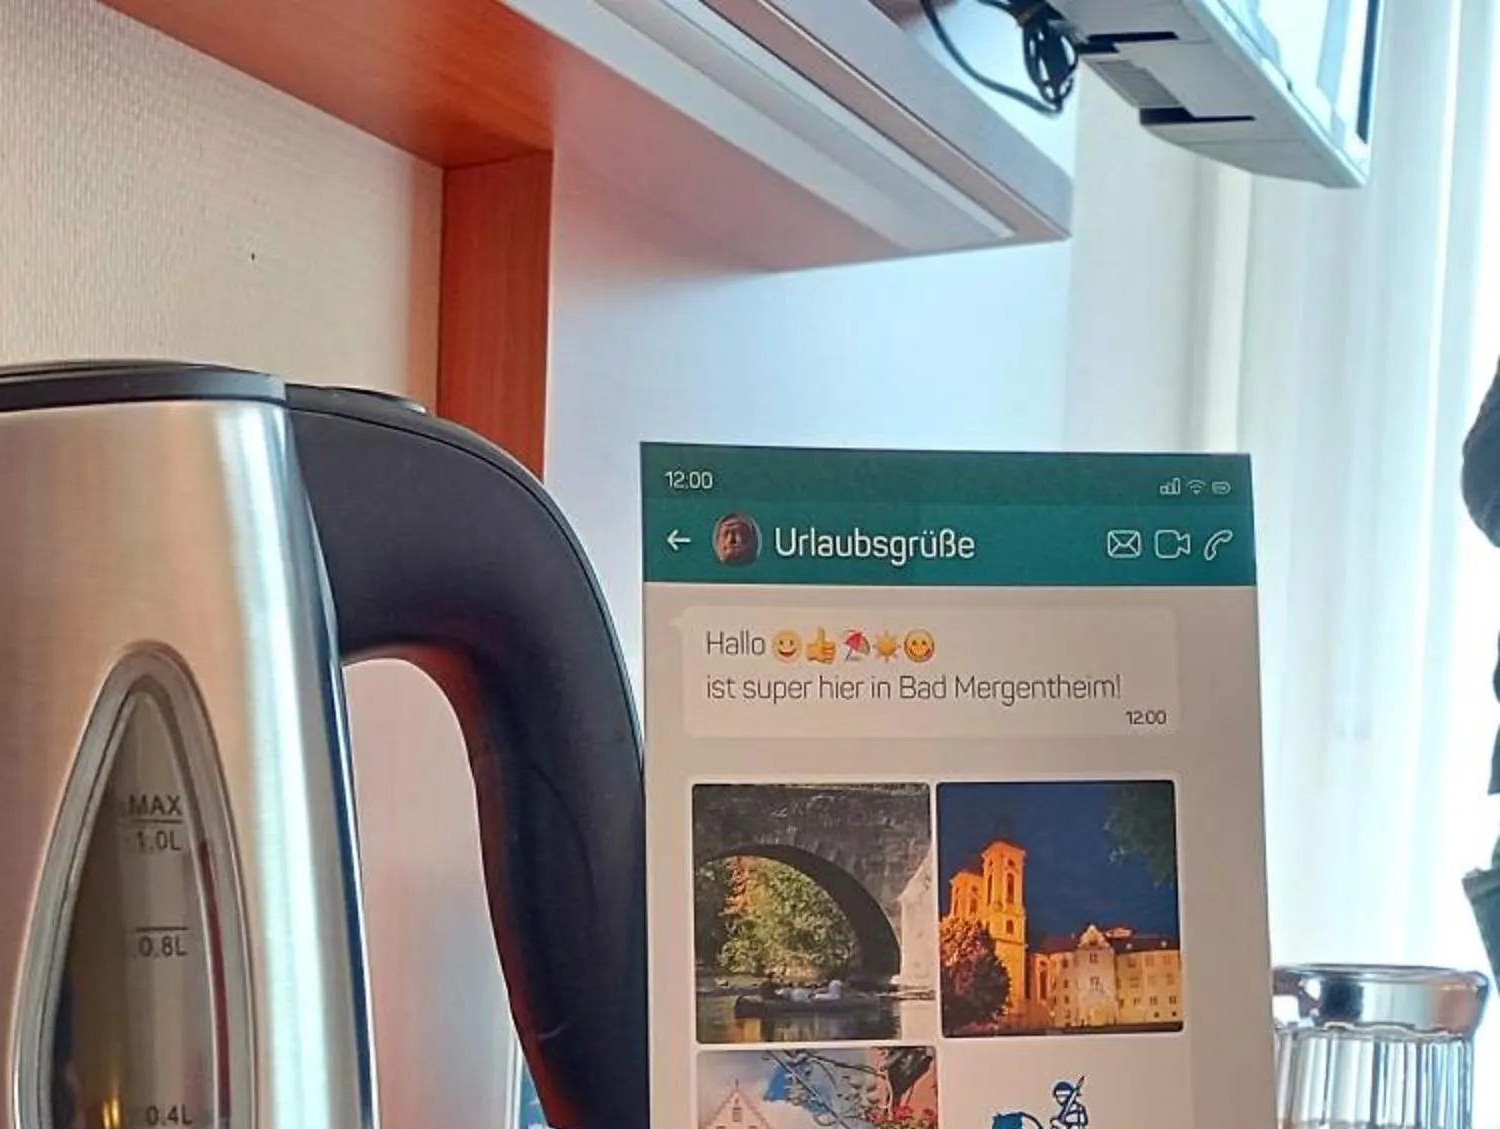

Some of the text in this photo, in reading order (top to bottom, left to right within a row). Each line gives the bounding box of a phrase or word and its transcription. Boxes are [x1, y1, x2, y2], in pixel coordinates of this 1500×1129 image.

[664, 470, 713, 490] 12:00
[774, 526, 976, 566] Urlaubsgrüße
[705, 630, 766, 657] Hallo
[705, 674, 1122, 707] ist super hier in Bad Mergentheim!
[1125, 710, 1167, 725] 1200
[129, 794, 182, 817] MAX
[136, 830, 181, 851] 1.0L
[139, 935, 187, 957] 0.8L
[146, 1104, 193, 1128] 0.4L
